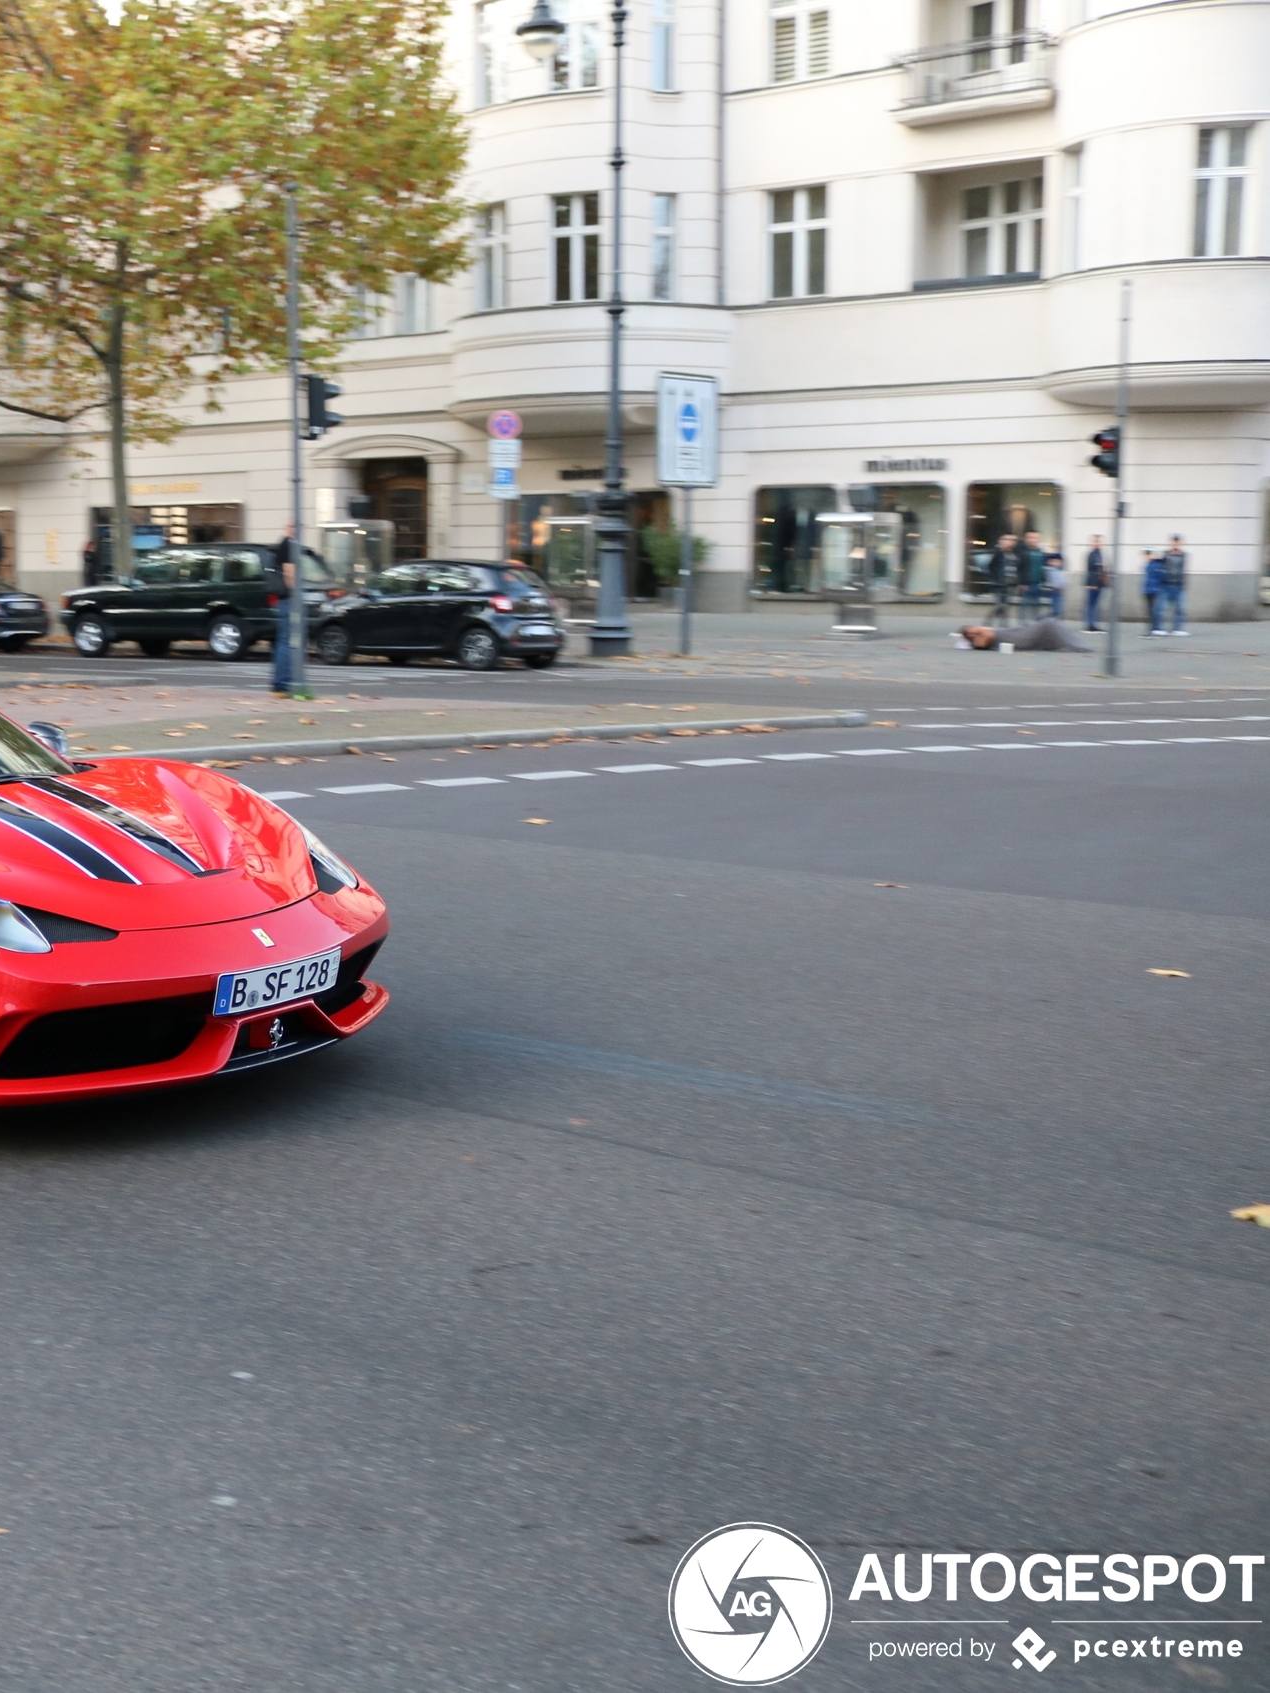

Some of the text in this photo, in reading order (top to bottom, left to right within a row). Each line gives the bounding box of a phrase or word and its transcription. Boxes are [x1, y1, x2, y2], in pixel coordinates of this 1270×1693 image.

[231, 959, 330, 1008] B SF 128
[220, 999, 227, 1007] D
